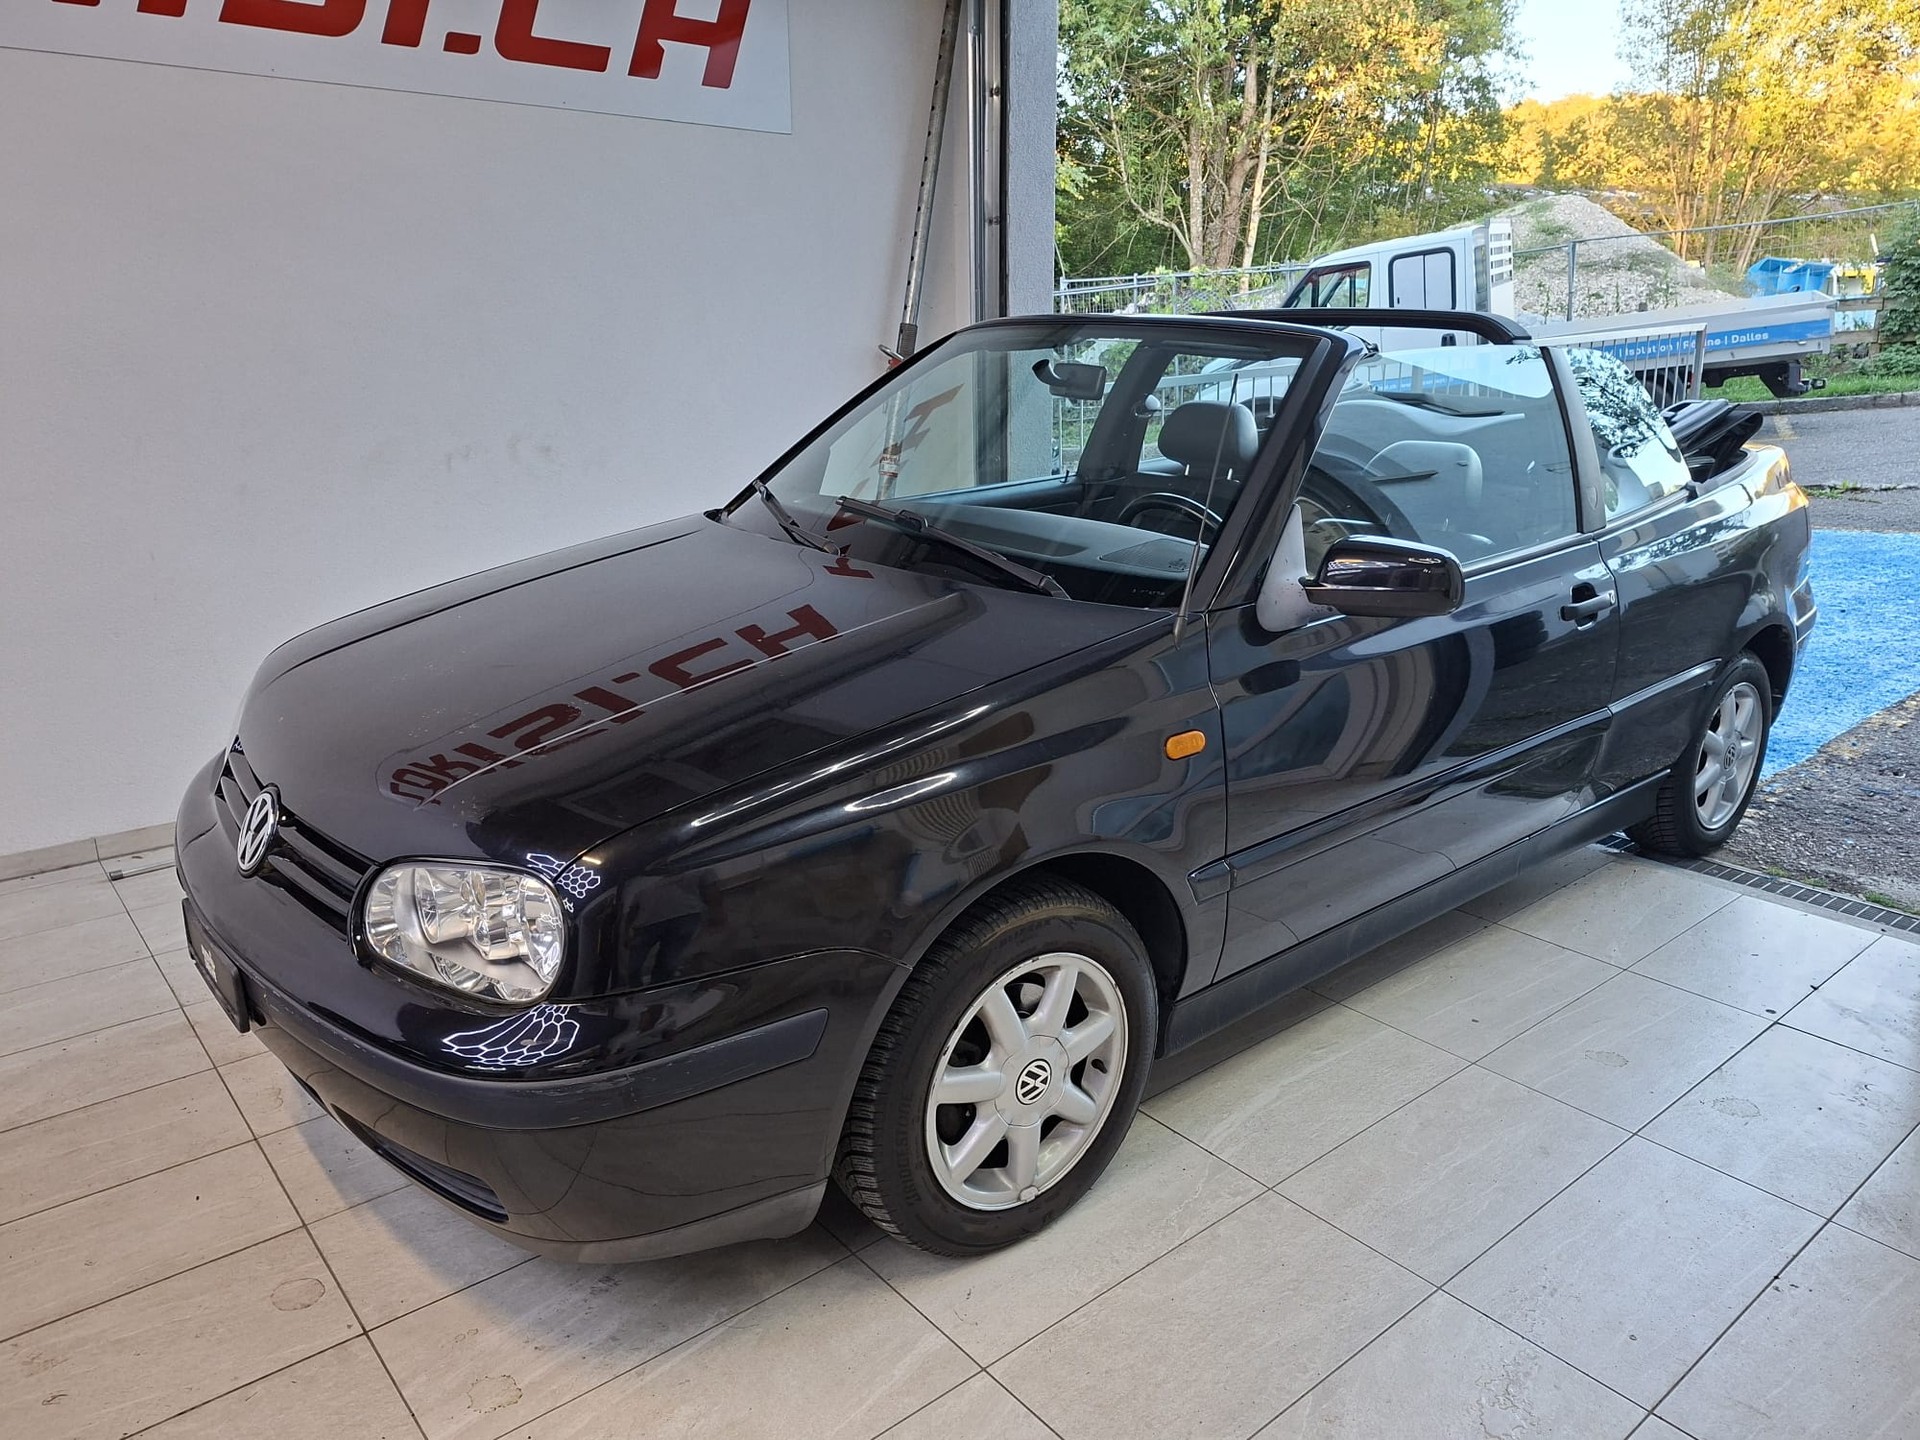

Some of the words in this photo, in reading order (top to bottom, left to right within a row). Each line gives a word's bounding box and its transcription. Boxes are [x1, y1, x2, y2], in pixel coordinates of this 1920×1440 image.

[1625, 344, 1673, 357] Isolaton
[1732, 332, 1769, 344] Dalles
[237, 793, 273, 871] VW
[1016, 1059, 1052, 1105] VW
